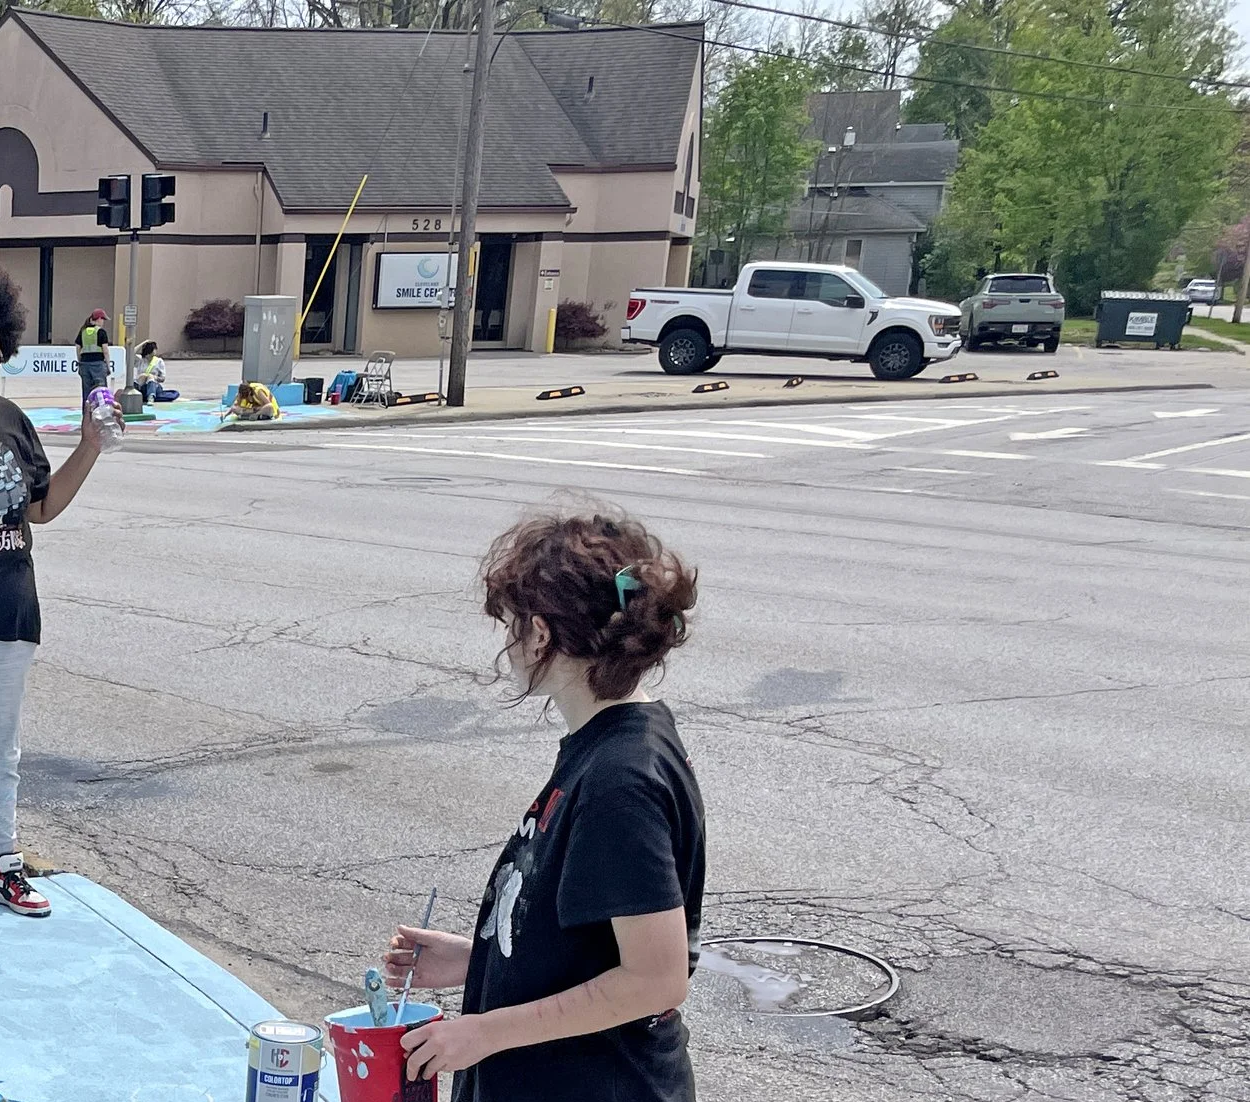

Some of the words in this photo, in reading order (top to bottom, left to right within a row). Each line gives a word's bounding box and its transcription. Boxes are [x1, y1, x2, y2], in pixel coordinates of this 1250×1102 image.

[412, 219, 442, 231] 528
[396, 288, 422, 298] SMILE
[33, 360, 67, 373] SMILE
[264, 1074, 293, 1085] COLORTOP
